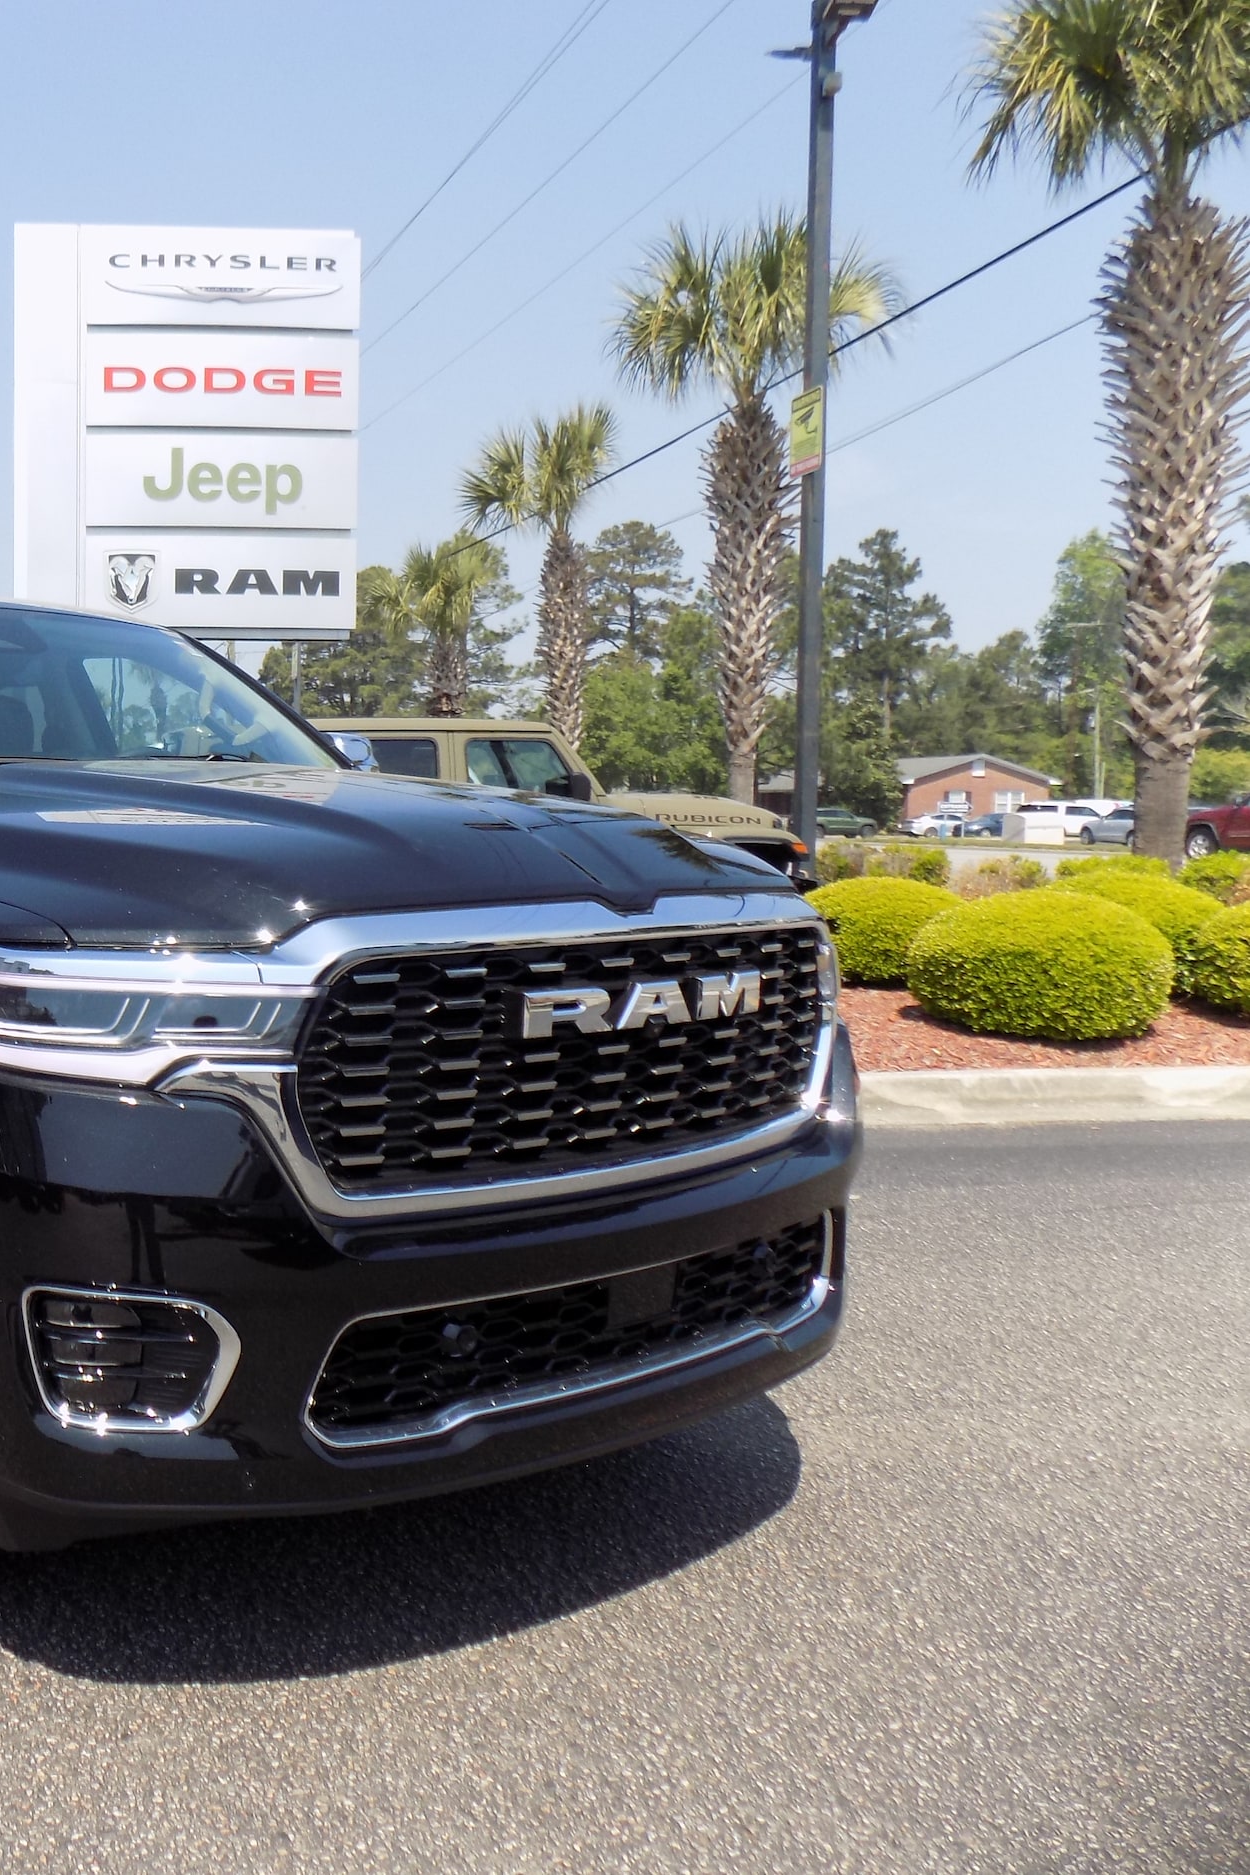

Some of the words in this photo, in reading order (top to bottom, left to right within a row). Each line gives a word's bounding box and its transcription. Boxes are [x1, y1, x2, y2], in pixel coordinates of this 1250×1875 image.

[108, 254, 337, 272] CHRYSLER
[103, 366, 342, 398] DODGE
[143, 447, 303, 515] Jeep
[174, 568, 340, 597] RAM
[655, 813, 761, 825] RUBICON
[522, 969, 760, 1040] RAM
